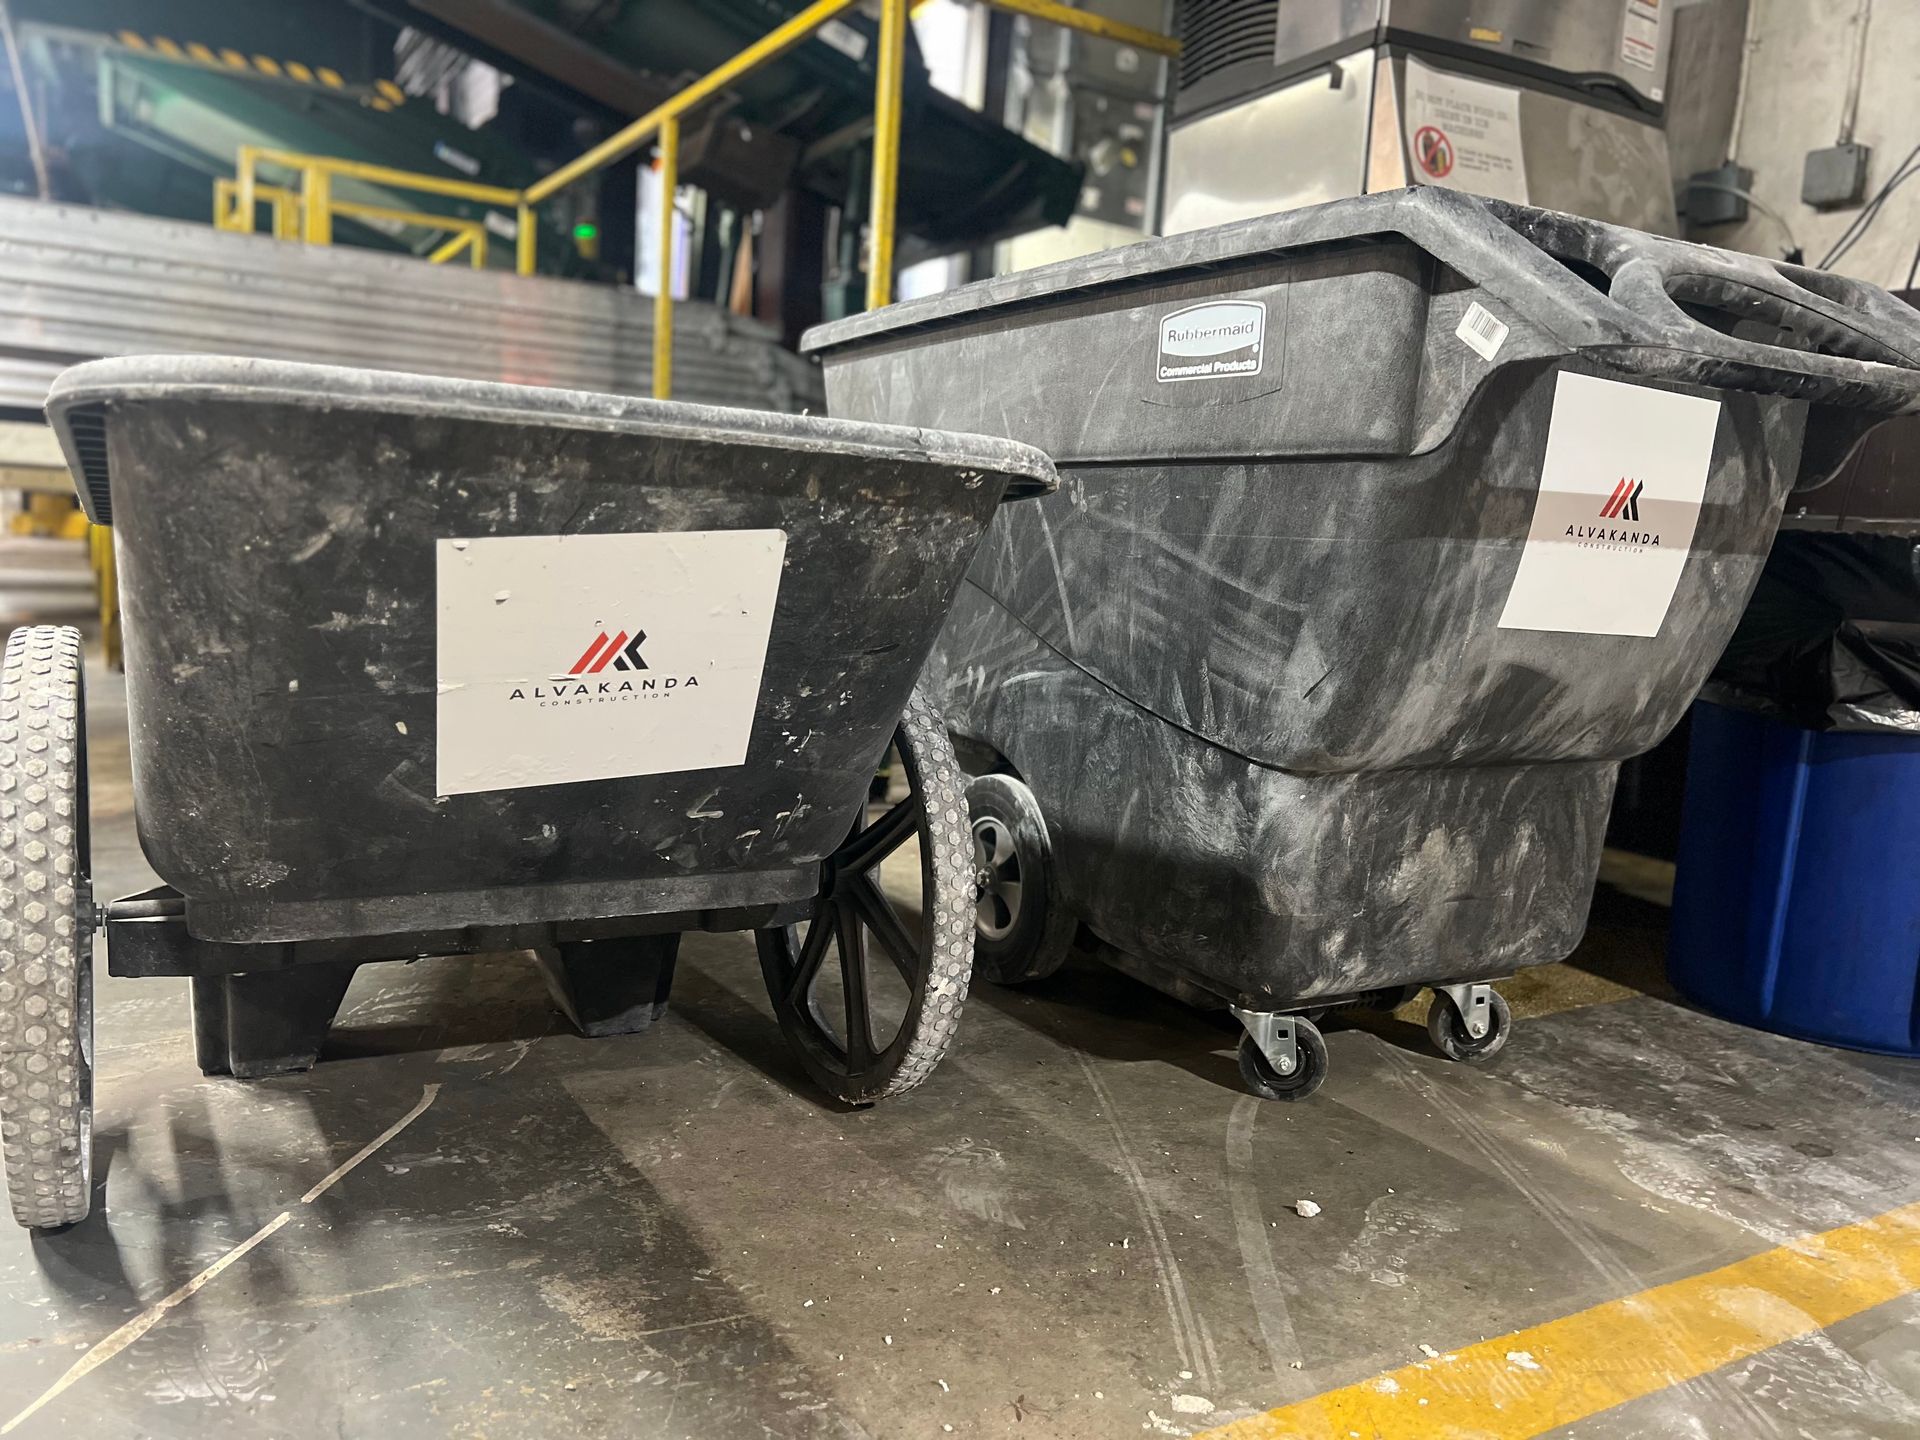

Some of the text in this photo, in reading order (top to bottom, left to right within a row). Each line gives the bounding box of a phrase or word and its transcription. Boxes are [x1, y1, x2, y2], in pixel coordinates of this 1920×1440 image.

[1167, 321, 1254, 342] Rubbermaid
[1160, 359, 1257, 377] Commercial Products
[1565, 524, 1660, 546] ALVAKANDA
[1577, 541, 1644, 554] CONSTRUCTION
[509, 676, 699, 700] ALVAKANDA
[539, 692, 670, 707] CONSTRUCTION
